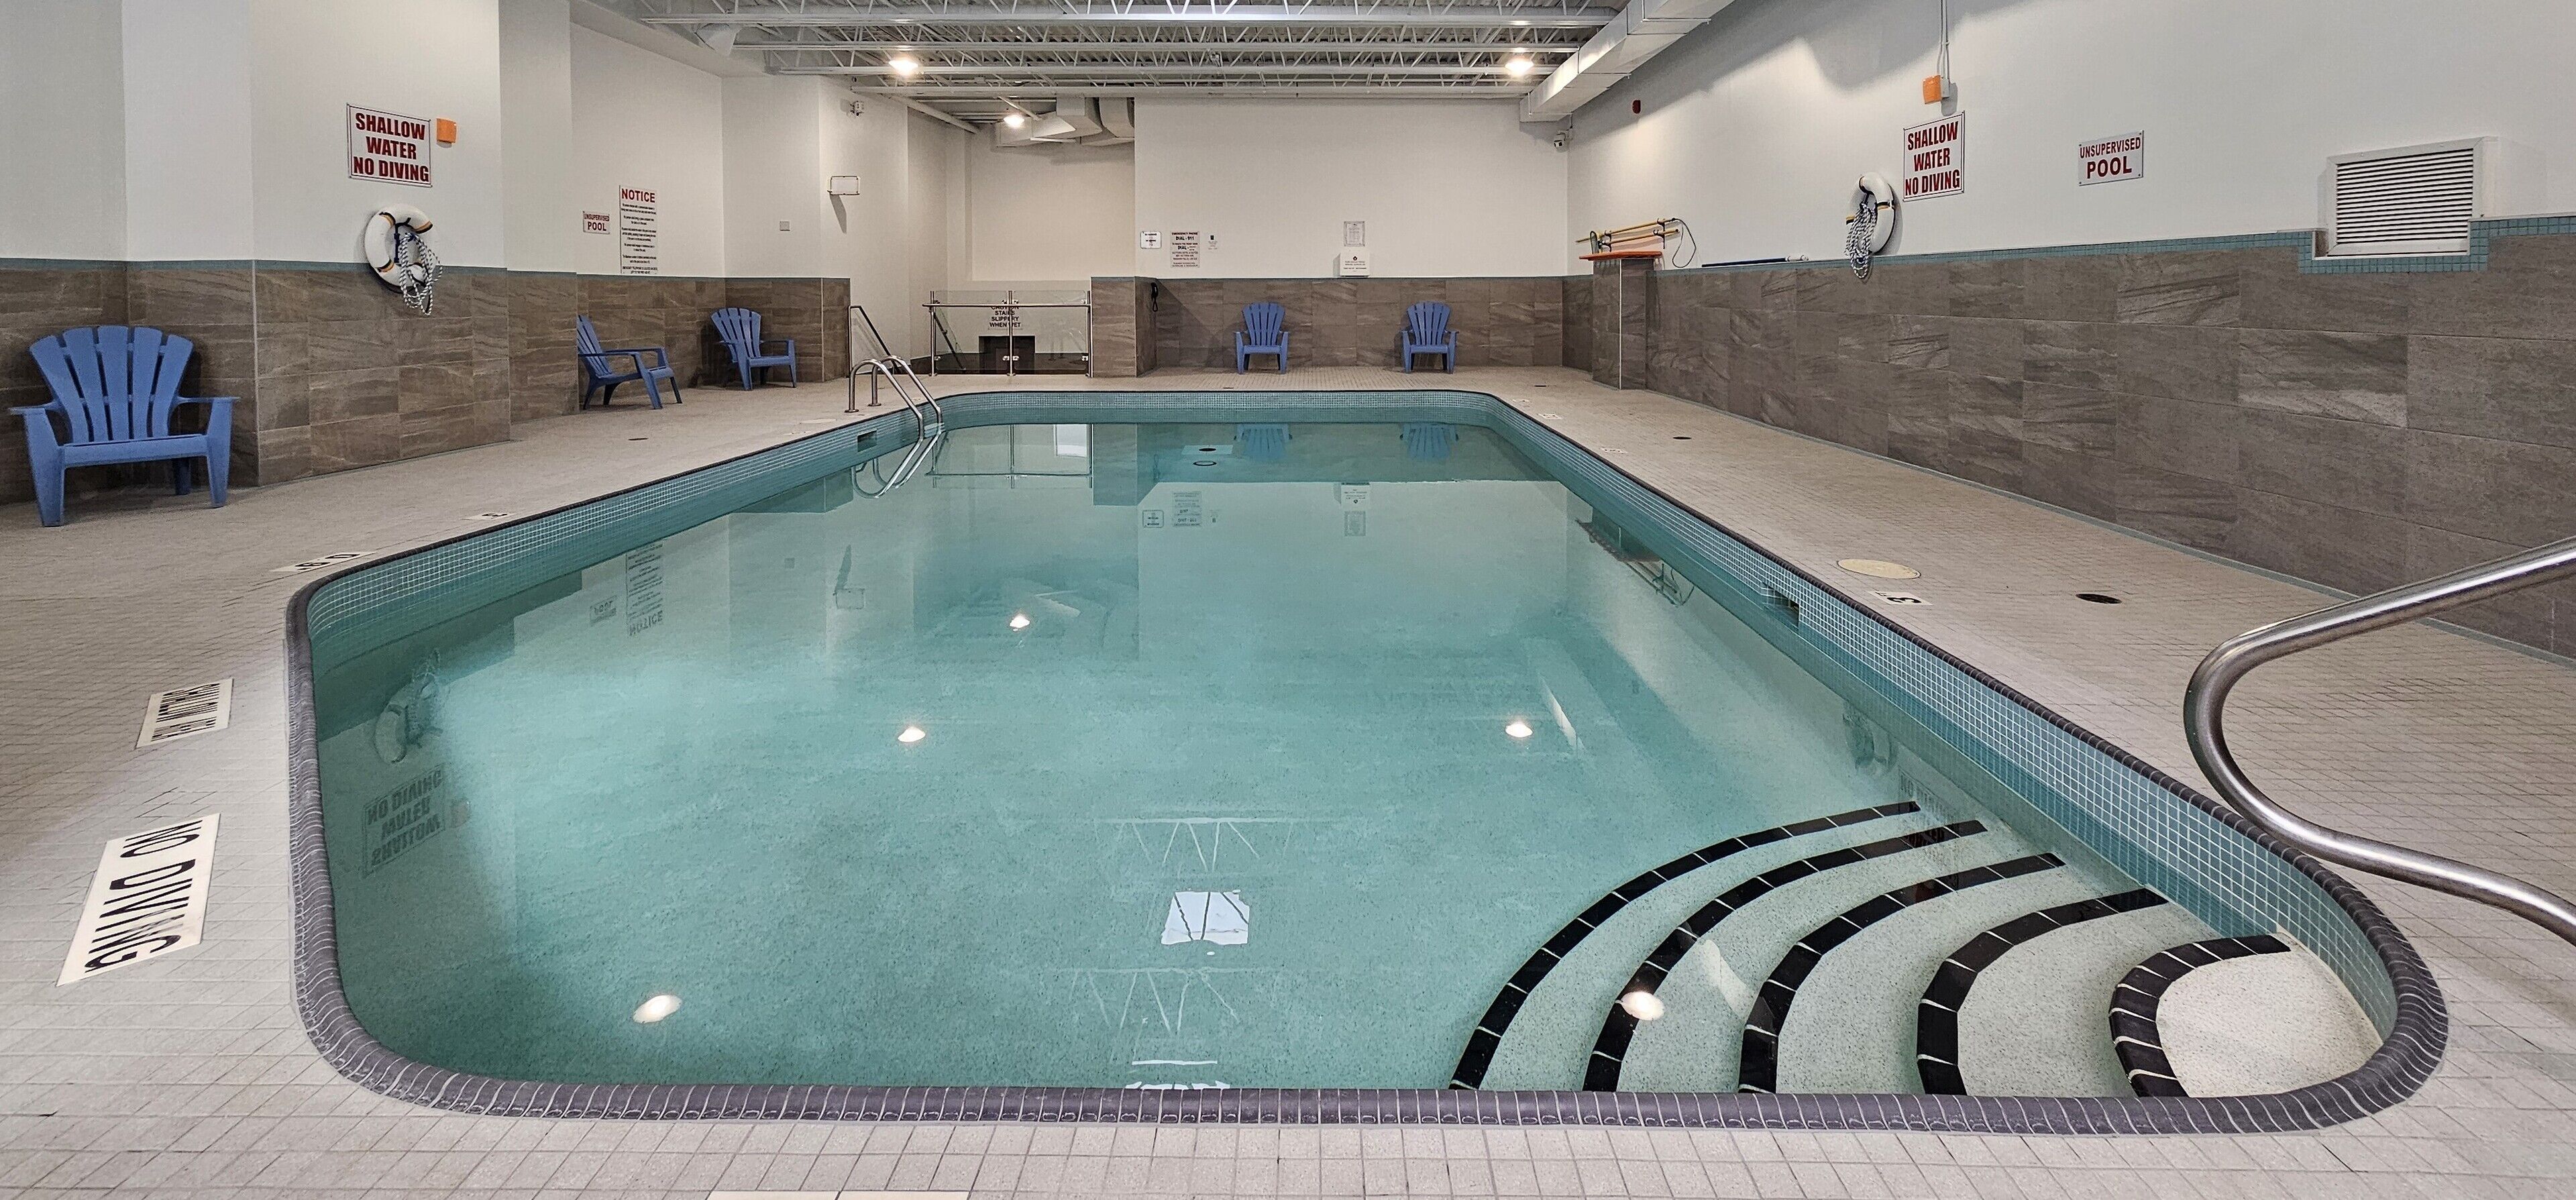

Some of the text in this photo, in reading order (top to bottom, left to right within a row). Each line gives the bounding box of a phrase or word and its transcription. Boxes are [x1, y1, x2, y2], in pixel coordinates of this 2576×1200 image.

[355, 113, 425, 140] SHALLOW
[1908, 121, 1958, 150] SHALLOW
[366, 136, 417, 160] WATER
[1914, 148, 1950, 172] WATER
[2080, 137, 2141, 158] UNSUPERVISED
[354, 156, 429, 182] NO DIVING
[2087, 156, 2132, 179] POOL
[1905, 169, 1960, 196] NO DIVING
[621, 188, 655, 203] NOTICE
[588, 221, 606, 231] POOL
[156, 683, 220, 722] SHALLOW
[85, 820, 203, 973] NO DIVING
